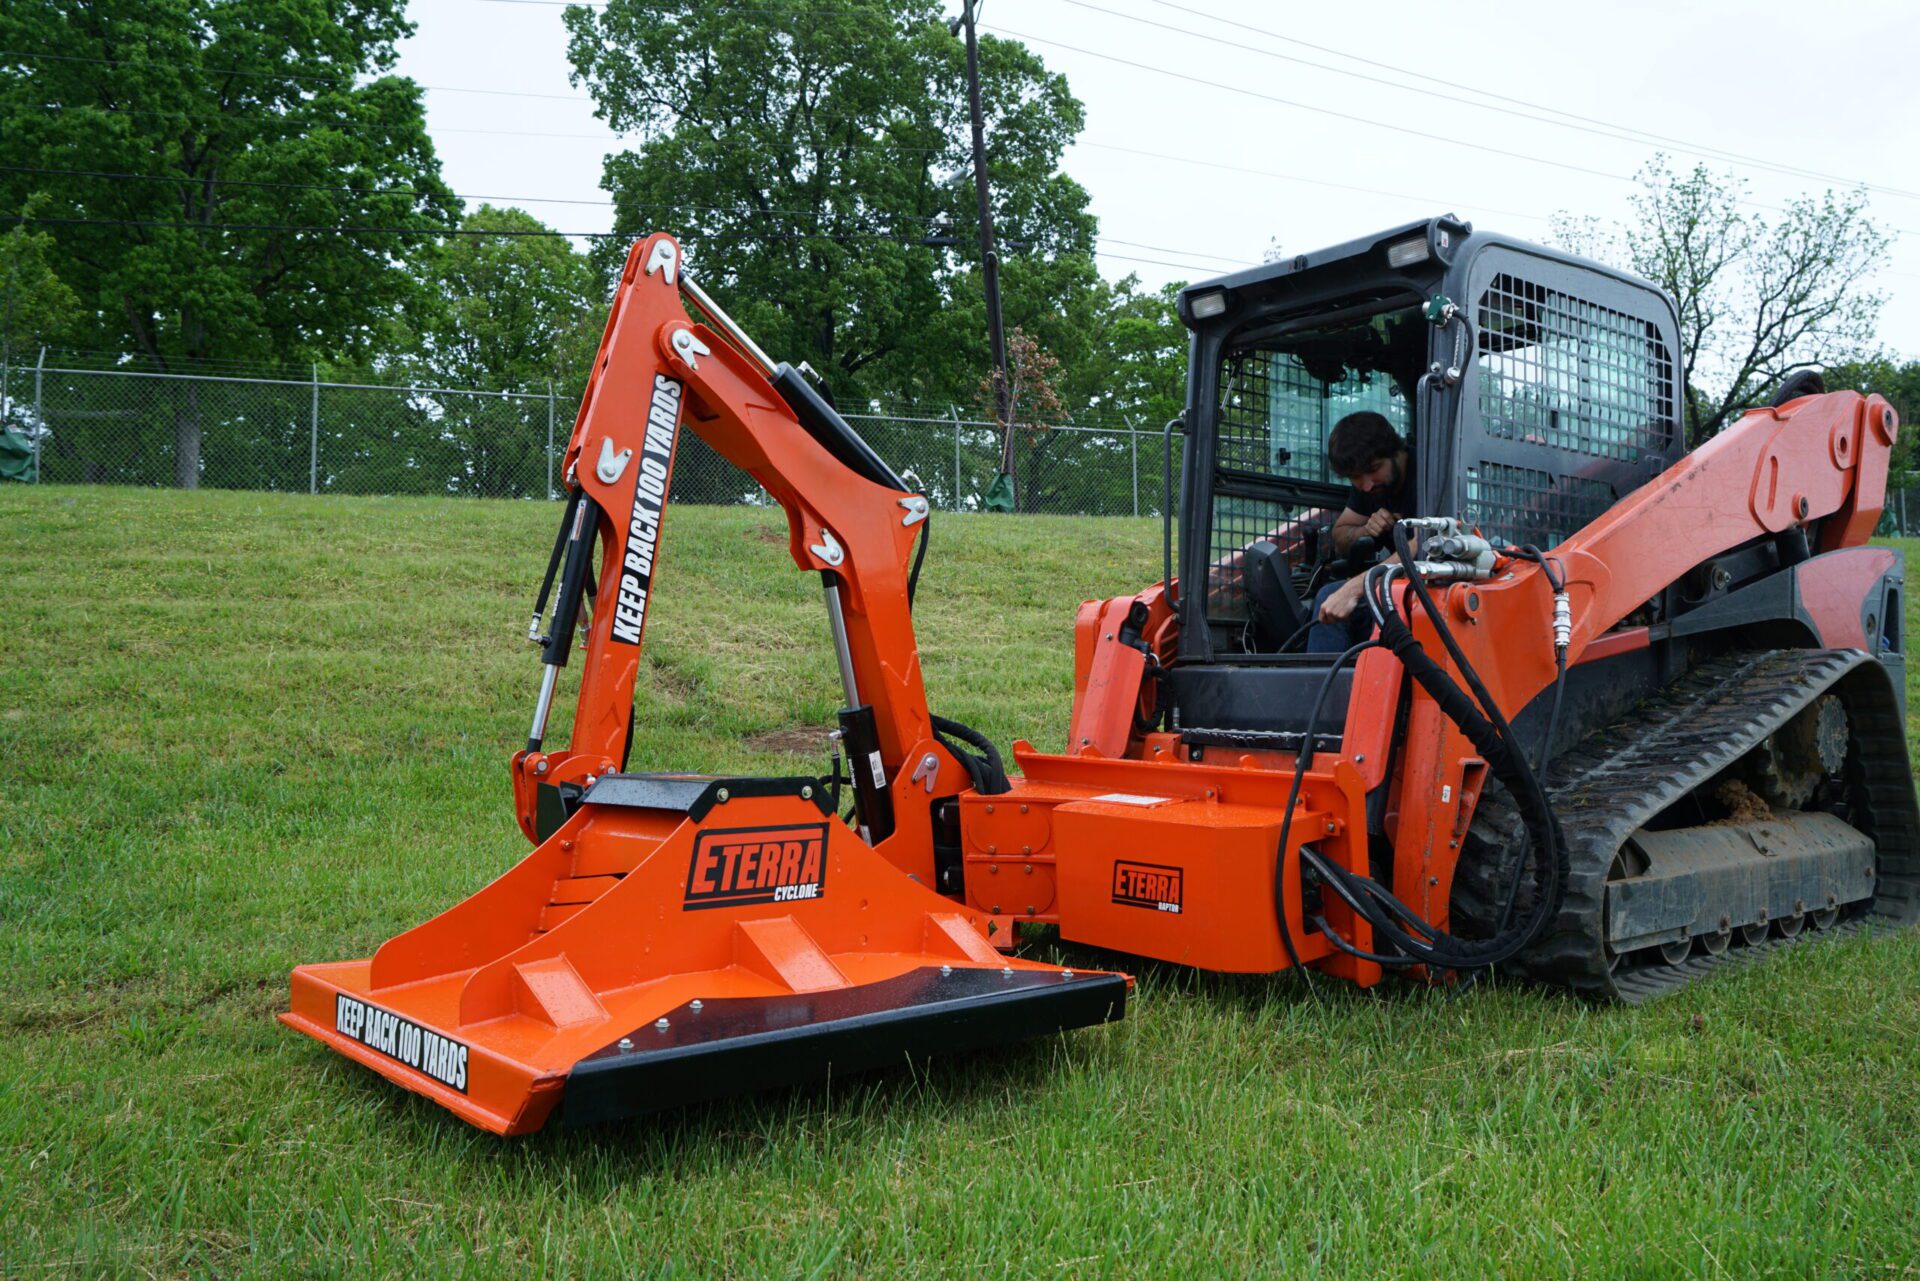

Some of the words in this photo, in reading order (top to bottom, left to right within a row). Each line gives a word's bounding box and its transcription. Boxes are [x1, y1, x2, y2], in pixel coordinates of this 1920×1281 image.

[644, 375, 681, 458] YARDS
[637, 457, 667, 506] 100
[624, 500, 660, 577] BACK
[613, 574, 647, 644] KEEP
[691, 828, 823, 894] ETERRA
[774, 884, 818, 901] CYCLONE
[1115, 863, 1180, 904] ETERRA
[337, 995, 364, 1039] KEEP
[365, 1006, 399, 1056] BACK
[398, 1021, 421, 1067] 100
[423, 1030, 467, 1090] YARDS
